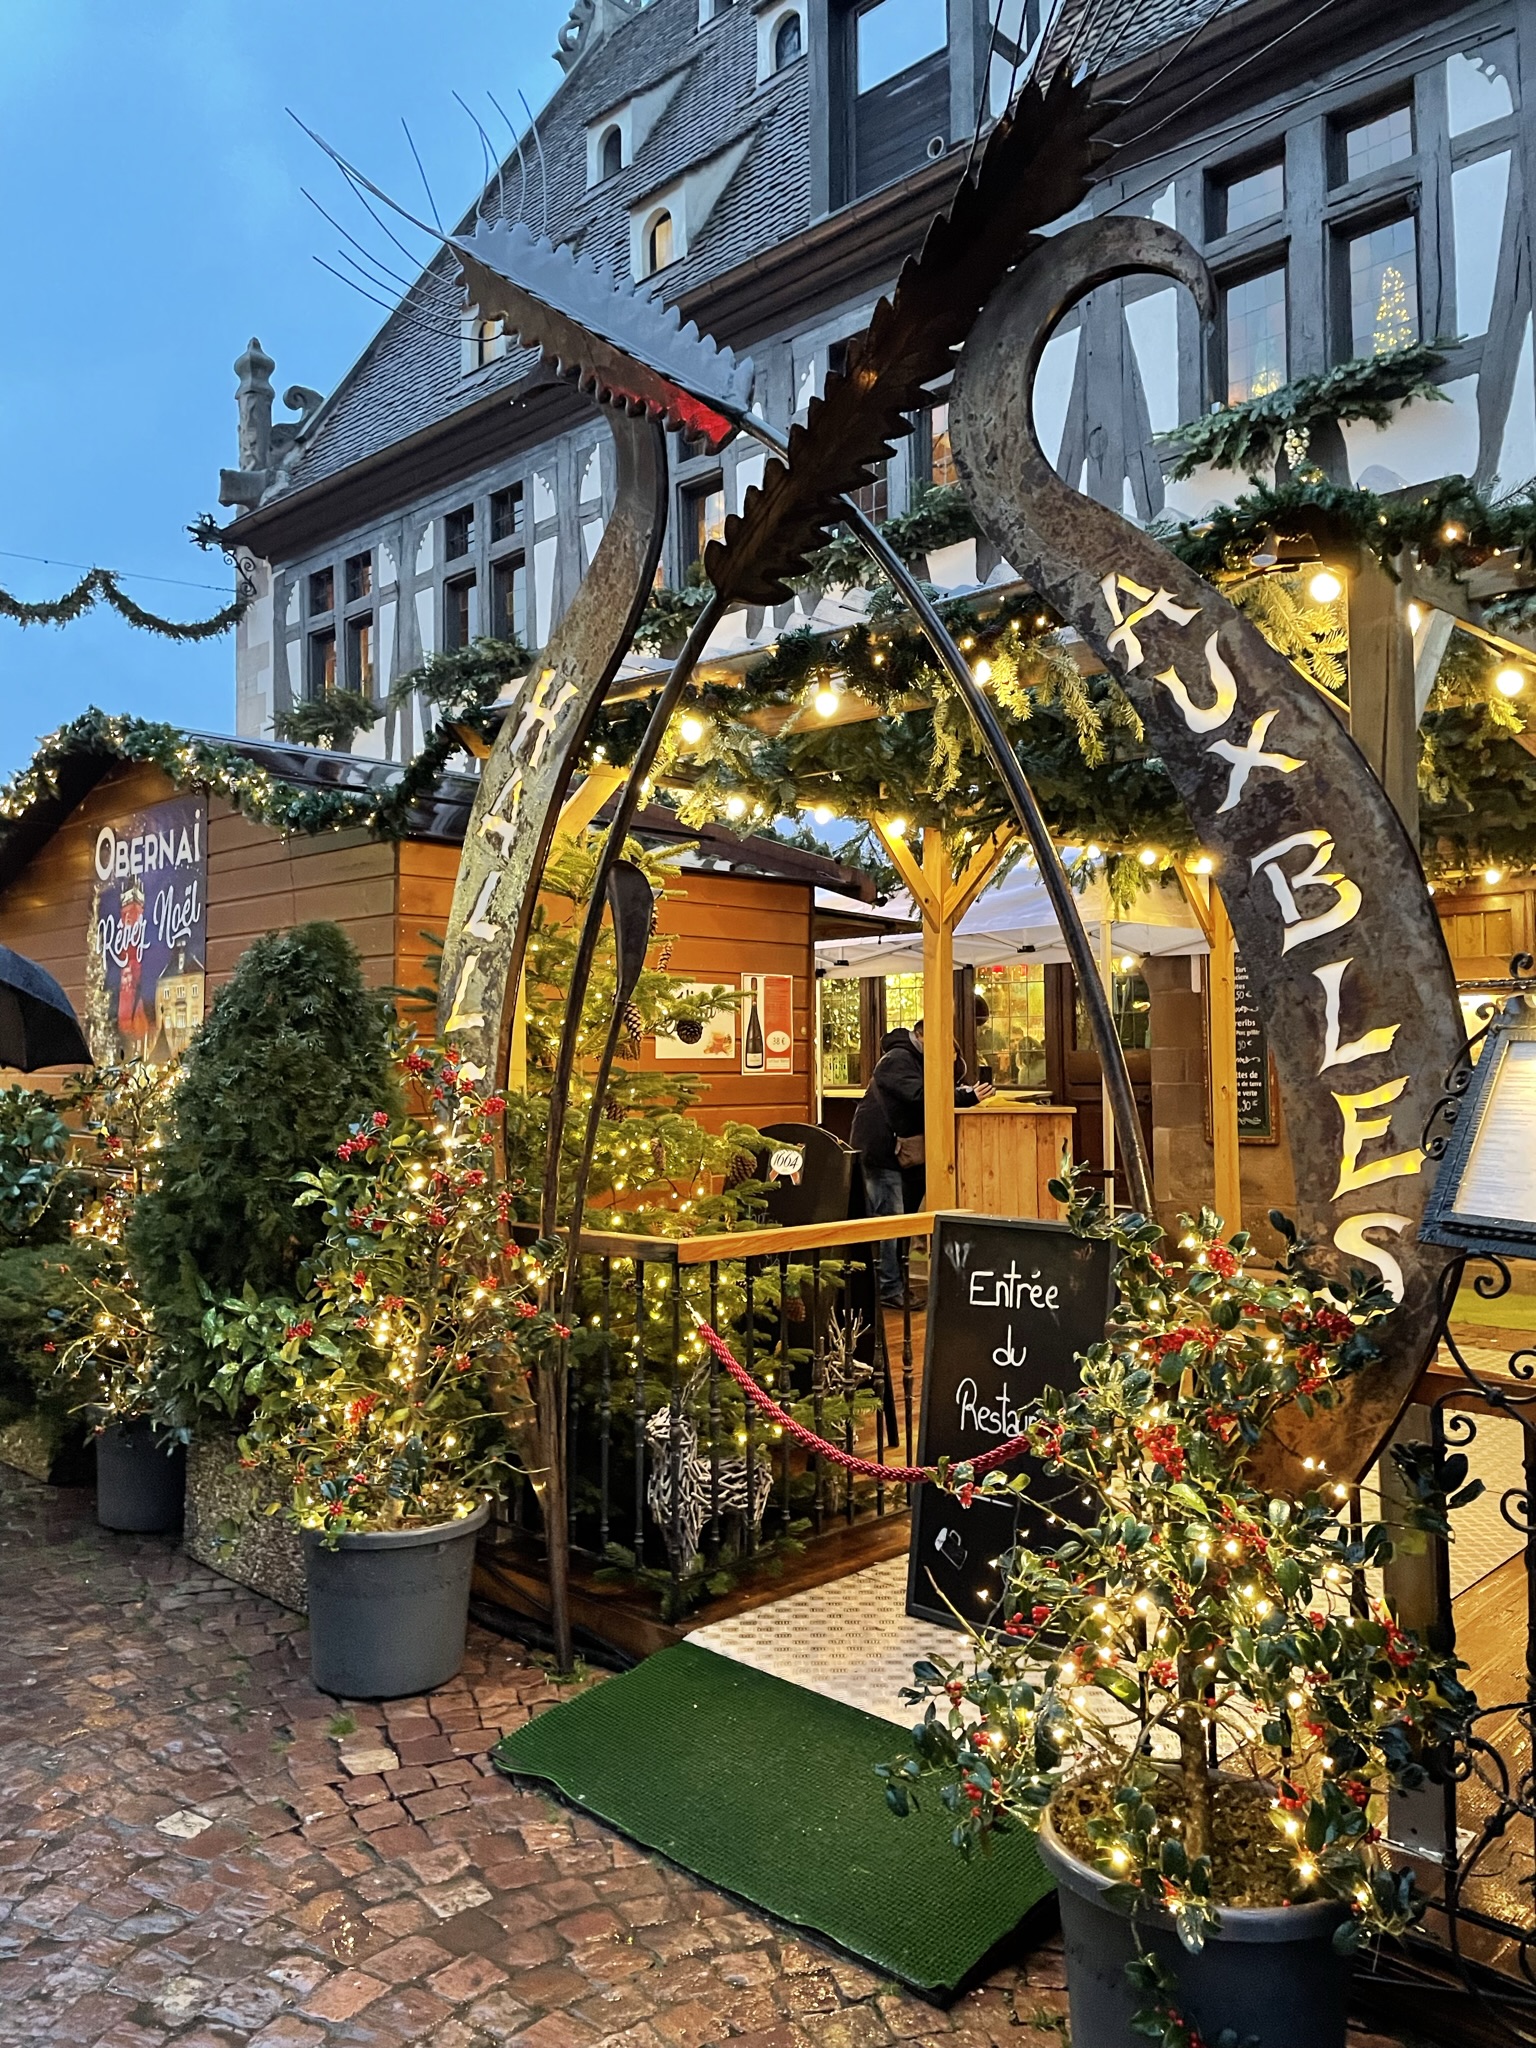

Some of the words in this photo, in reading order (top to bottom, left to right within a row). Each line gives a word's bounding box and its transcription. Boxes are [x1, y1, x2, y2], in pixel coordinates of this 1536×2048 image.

[153, 879, 201, 949] Noël
[1101, 571, 1308, 814] AUX
[1250, 828, 1433, 1326] BLES
[773, 1151, 800, 1170] 1664
[969, 1260, 1061, 1310] Entrée
[992, 1324, 1027, 1367] du
